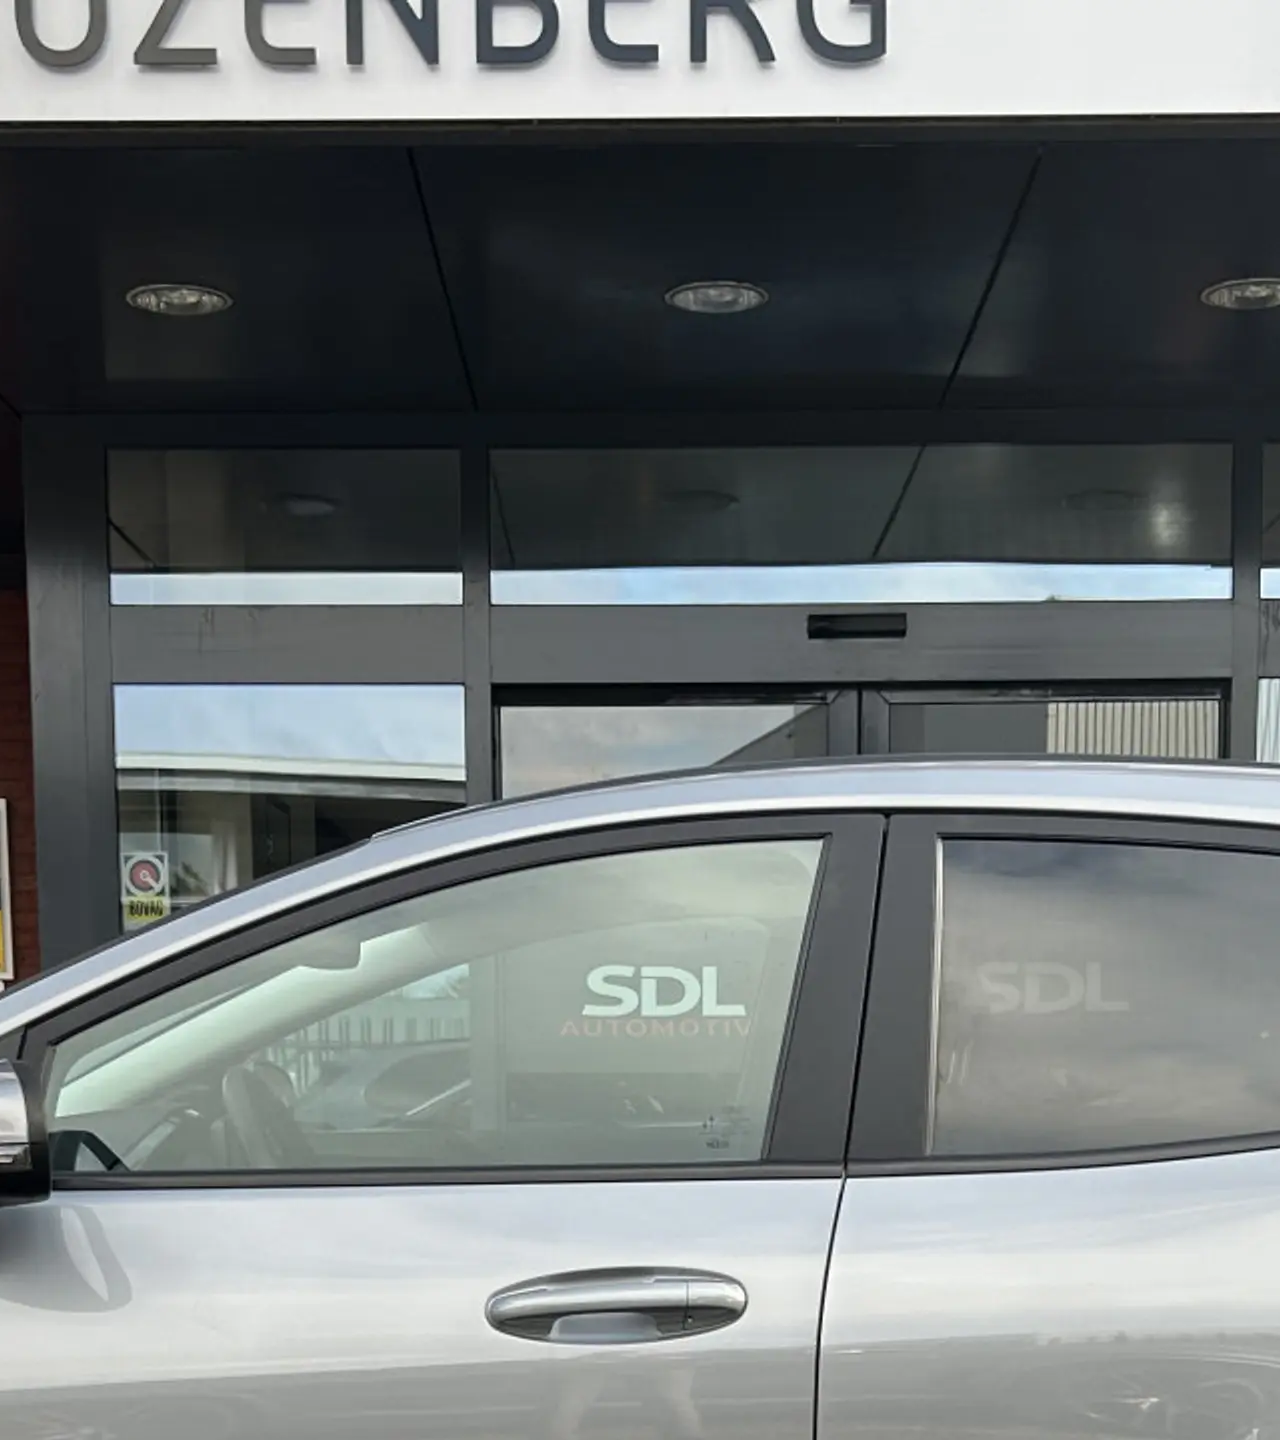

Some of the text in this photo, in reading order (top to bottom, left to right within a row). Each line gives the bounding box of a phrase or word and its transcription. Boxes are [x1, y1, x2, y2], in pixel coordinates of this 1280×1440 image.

[129, 900, 163, 917] BOVAG
[582, 965, 746, 1016] SDL
[977, 962, 1130, 1013] SDL
